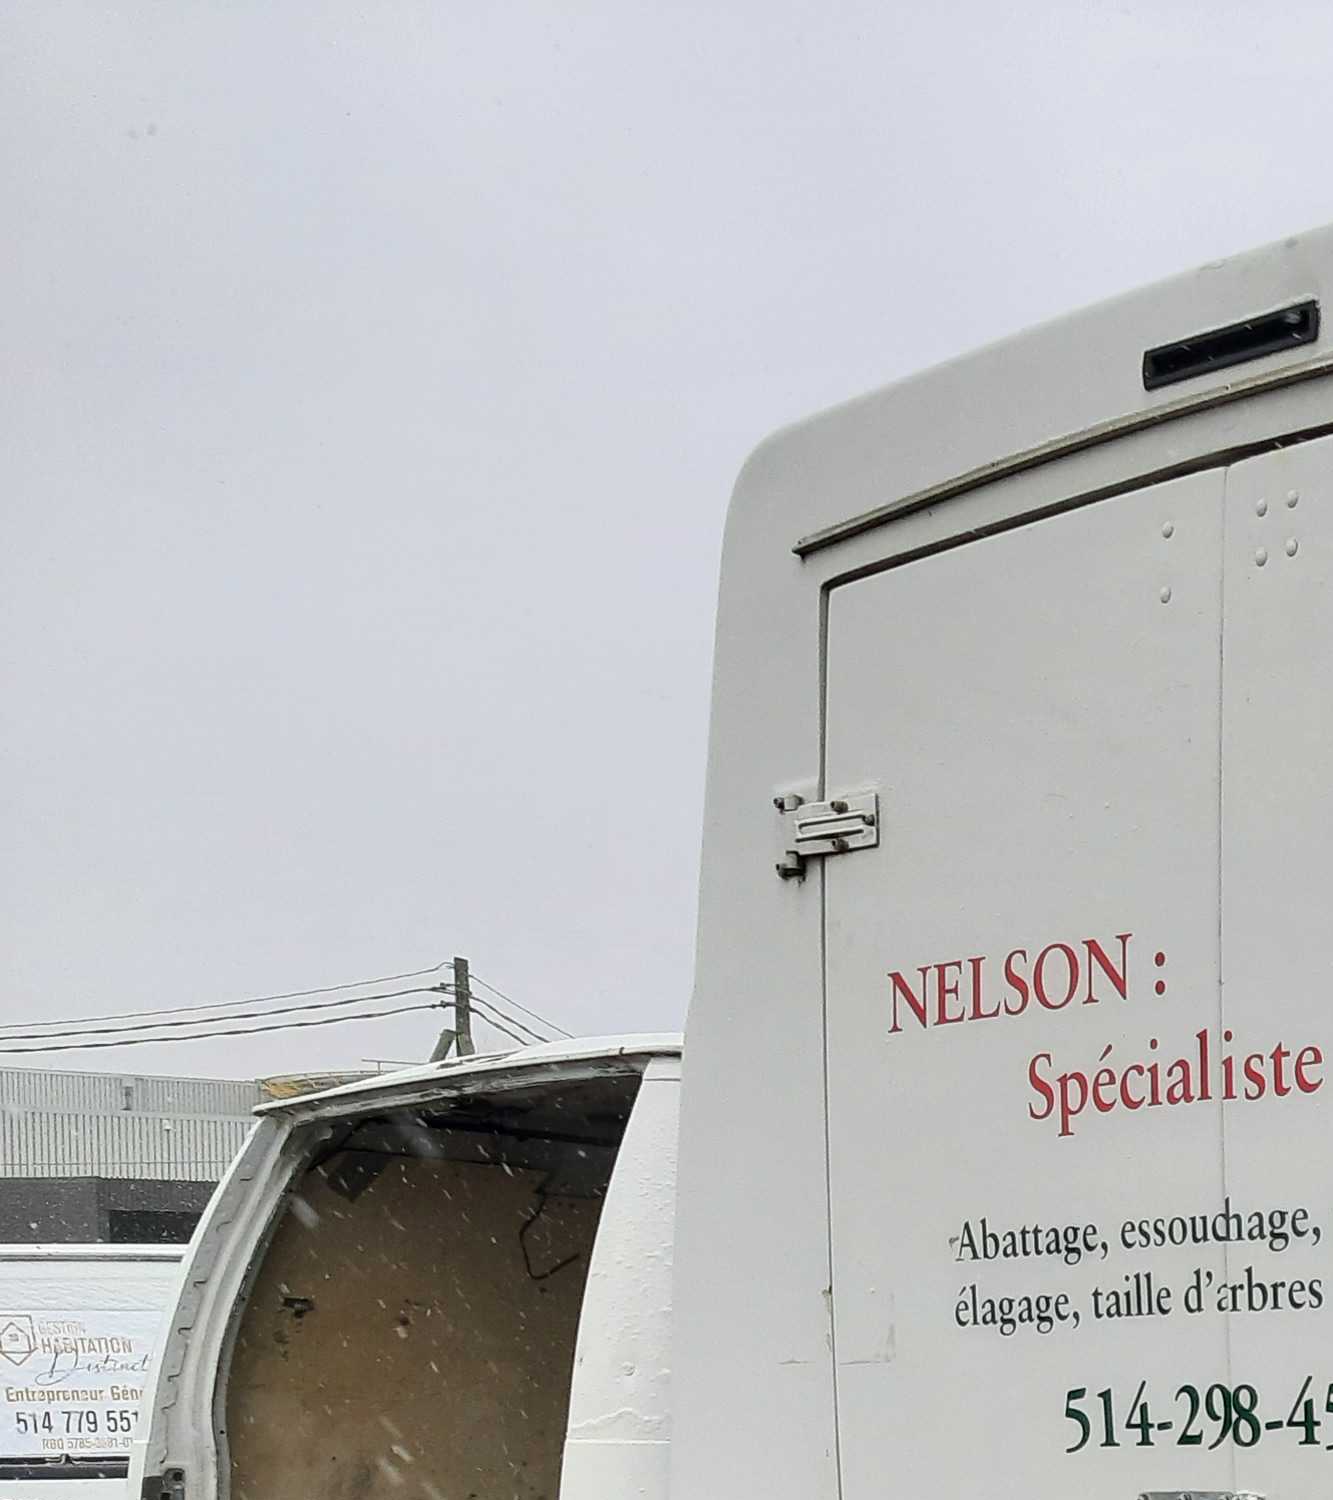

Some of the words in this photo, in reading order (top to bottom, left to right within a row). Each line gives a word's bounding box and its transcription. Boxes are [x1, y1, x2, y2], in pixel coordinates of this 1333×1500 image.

[888, 933, 1132, 1034] NELSON
[1027, 1030, 1324, 1137] Spécialiste
[953, 1217, 1109, 1265] Abattage,
[1120, 1197, 1322, 1252] essouchage,
[955, 1284, 1081, 1336] élagage,
[1091, 1272, 1172, 1319] taille
[1183, 1265, 1324, 1313] d'arbres
[41, 1337, 133, 1354] HABITATION
[6, 1387, 104, 1404] Entrepreneur
[16, 1411, 54, 1434] 514
[62, 1410, 99, 1433] 779
